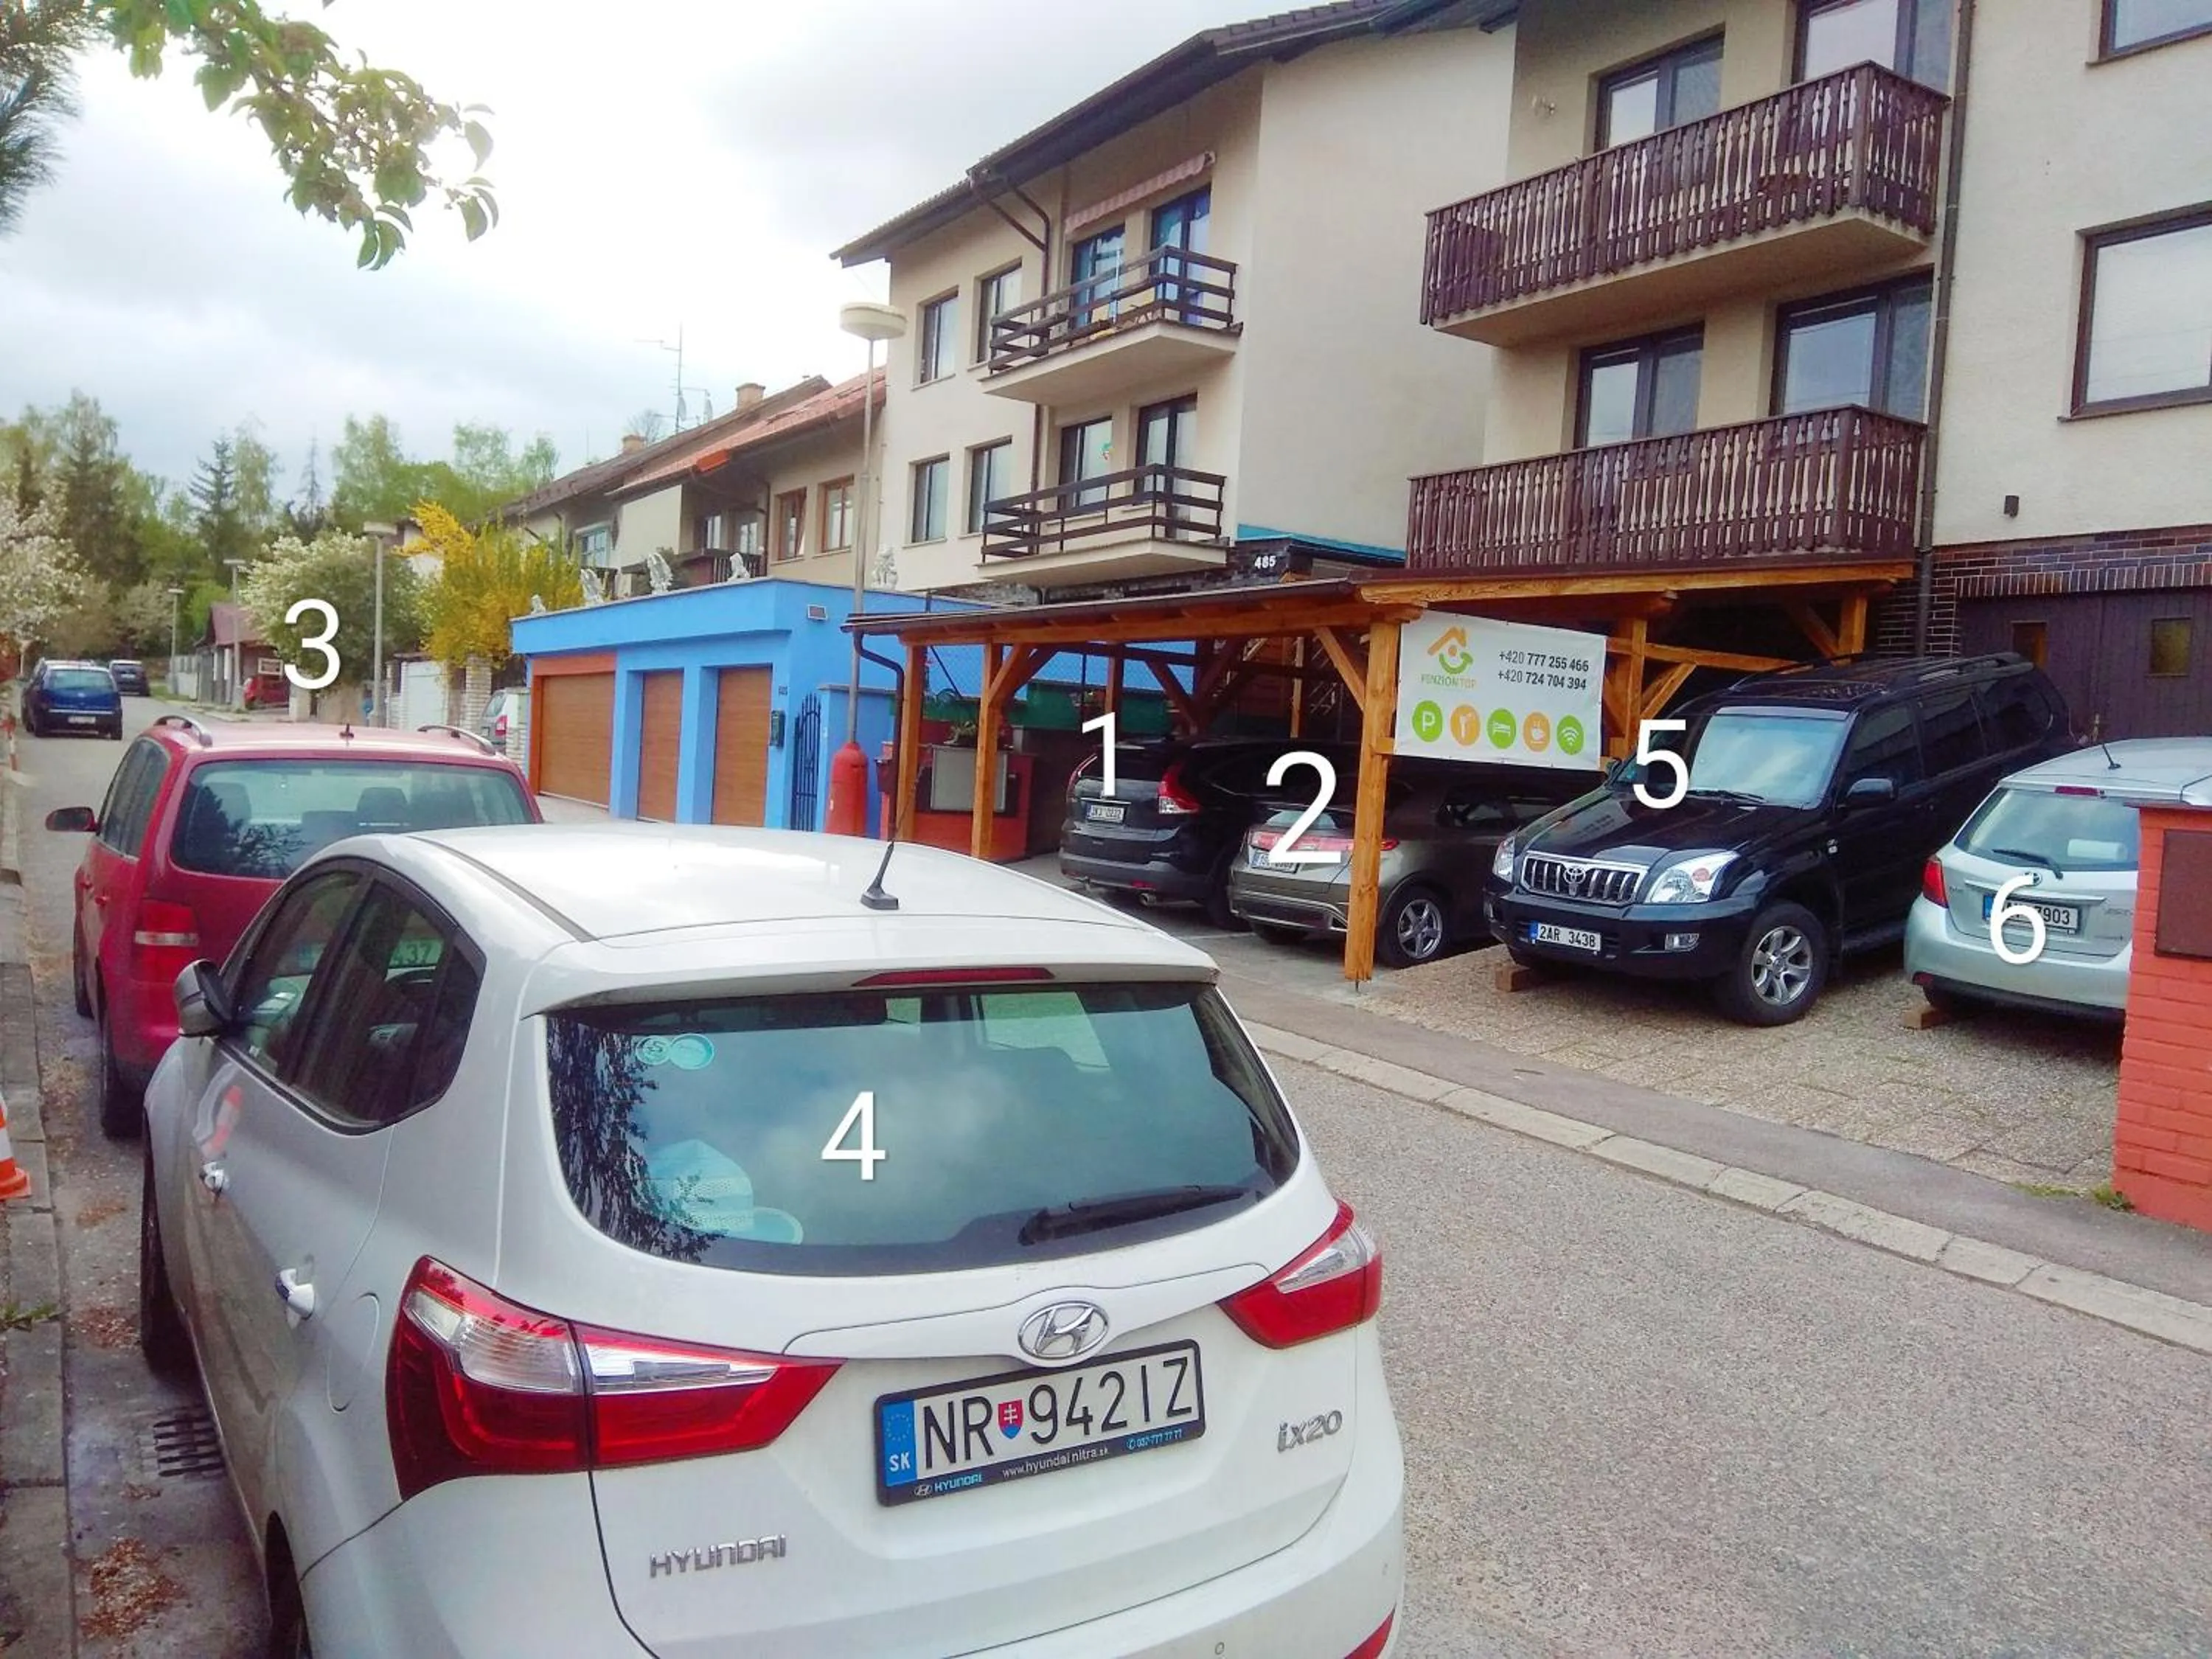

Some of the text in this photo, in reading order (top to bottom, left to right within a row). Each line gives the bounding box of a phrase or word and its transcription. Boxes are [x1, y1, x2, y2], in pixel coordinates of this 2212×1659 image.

[1499, 650, 1589, 672] +420 777 255 466
[1498, 669, 1586, 690] +420 724 704 394
[1540, 926, 1560, 941] 2AR
[923, 1396, 995, 1470] NR
[1277, 1410, 1343, 1453] ix20
[889, 1451, 911, 1472] SK
[934, 1473, 983, 1492] HYUNDAI
[650, 1534, 787, 1578] HYUNDAI
